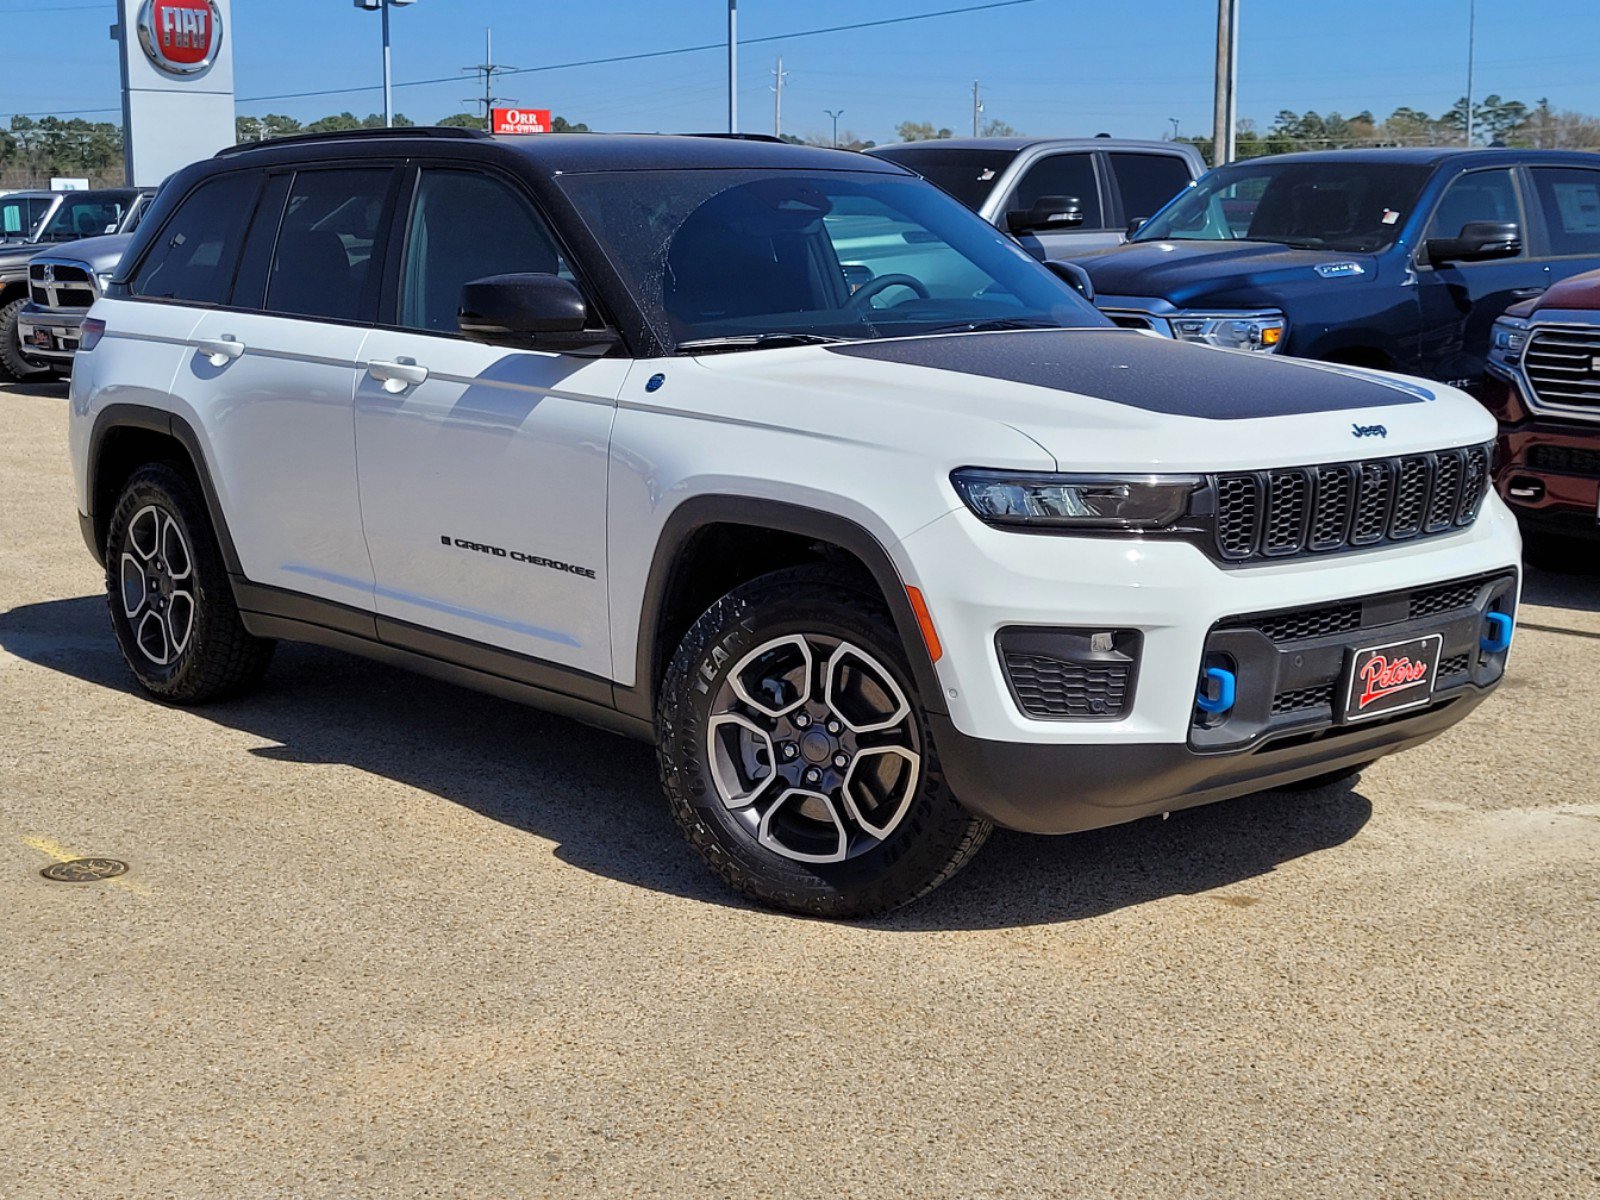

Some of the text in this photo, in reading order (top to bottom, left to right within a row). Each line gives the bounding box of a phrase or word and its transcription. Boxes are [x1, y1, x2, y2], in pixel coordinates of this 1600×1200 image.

[161, 6, 208, 49] FIAT
[1351, 423, 1388, 439] Jeep
[454, 538, 596, 579] GRAND CHEROKEE
[1360, 655, 1427, 709] Peters
